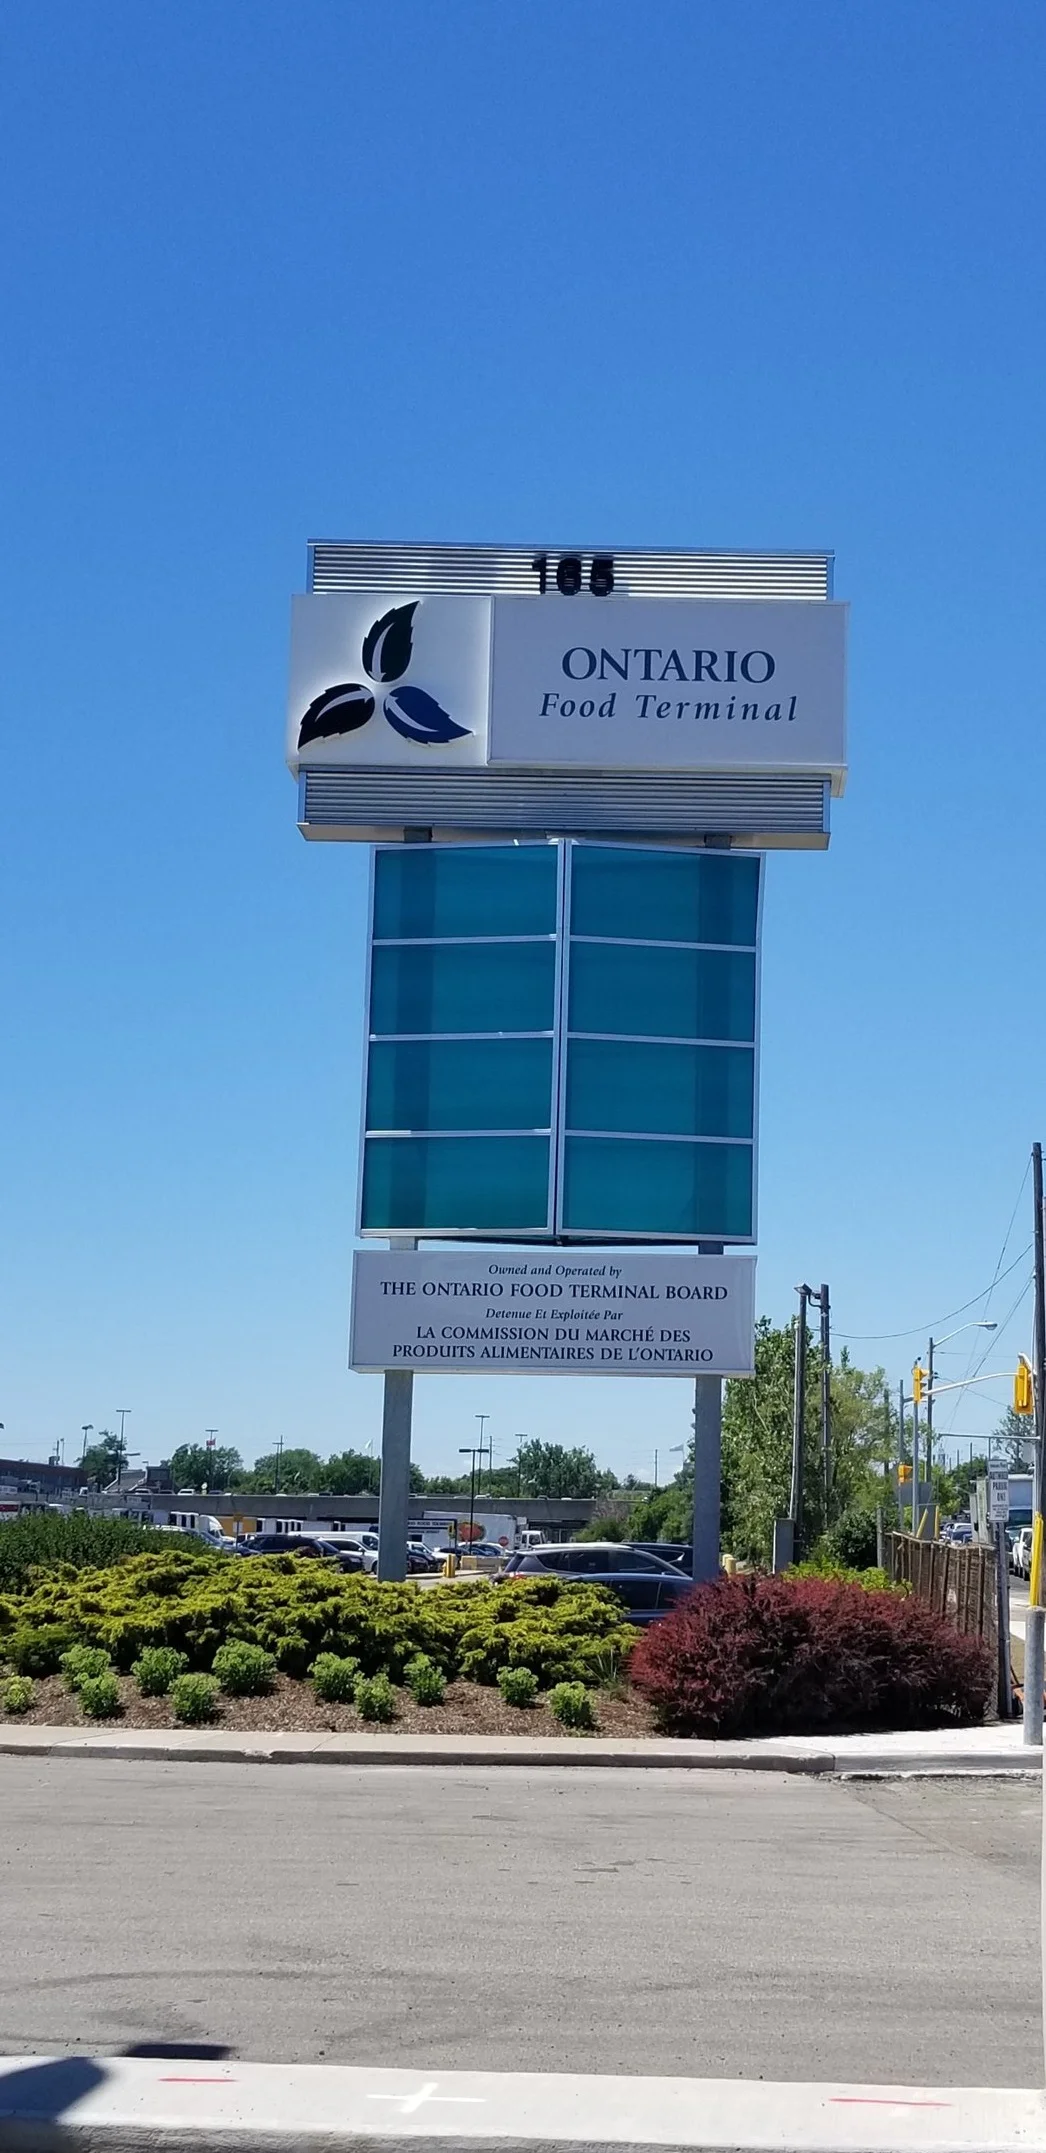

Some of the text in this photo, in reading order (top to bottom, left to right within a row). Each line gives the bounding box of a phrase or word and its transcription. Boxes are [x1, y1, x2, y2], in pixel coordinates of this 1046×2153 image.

[532, 557, 614, 597] 165
[561, 646, 776, 684] ONTARIO
[538, 692, 797, 722] Food Terminal
[488, 1264, 623, 1280] Owned and Operated by
[379, 1281, 728, 1301] THE ONTARIO FOOD TERMINAL BOARD
[485, 1308, 624, 1323] Detenue Et Exploitée Par
[416, 1325, 691, 1343] LA COMMISSION DU MARCHÉ DES
[392, 1344, 476, 1359] PRODUITS
[479, 1345, 595, 1360] ALIMENTAIRES
[600, 1347, 623, 1361] DE
